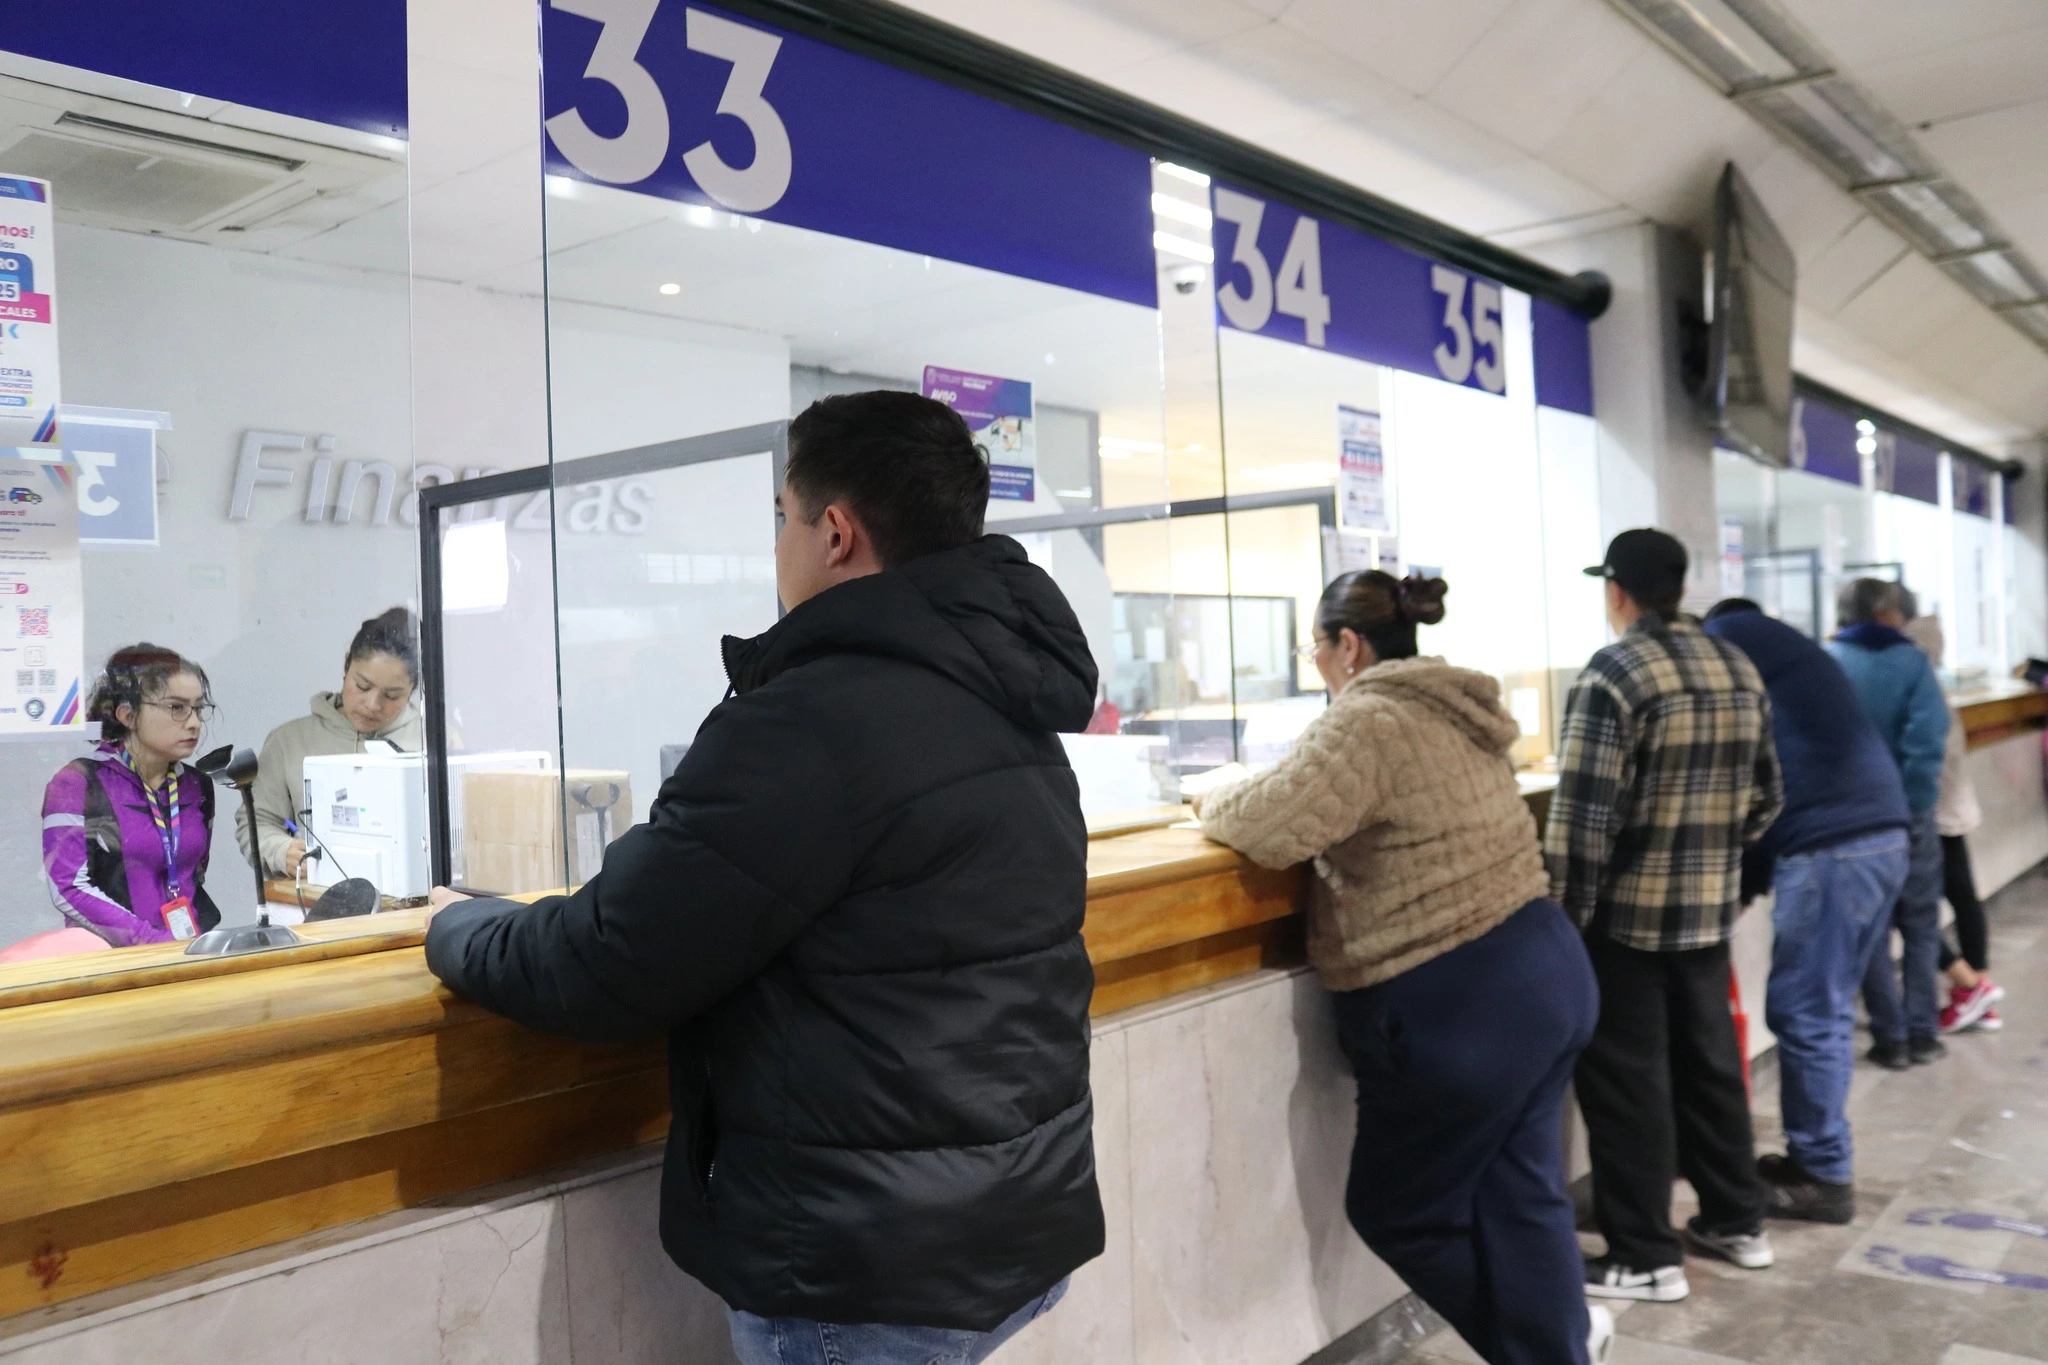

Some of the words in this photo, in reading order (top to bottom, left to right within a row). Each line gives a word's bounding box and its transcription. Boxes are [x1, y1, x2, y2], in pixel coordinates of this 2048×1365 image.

[545, 0, 792, 213] 33
[1215, 187, 1331, 348] 34
[1431, 264, 1505, 393] 35
[229, 429, 656, 534] Finanzas
